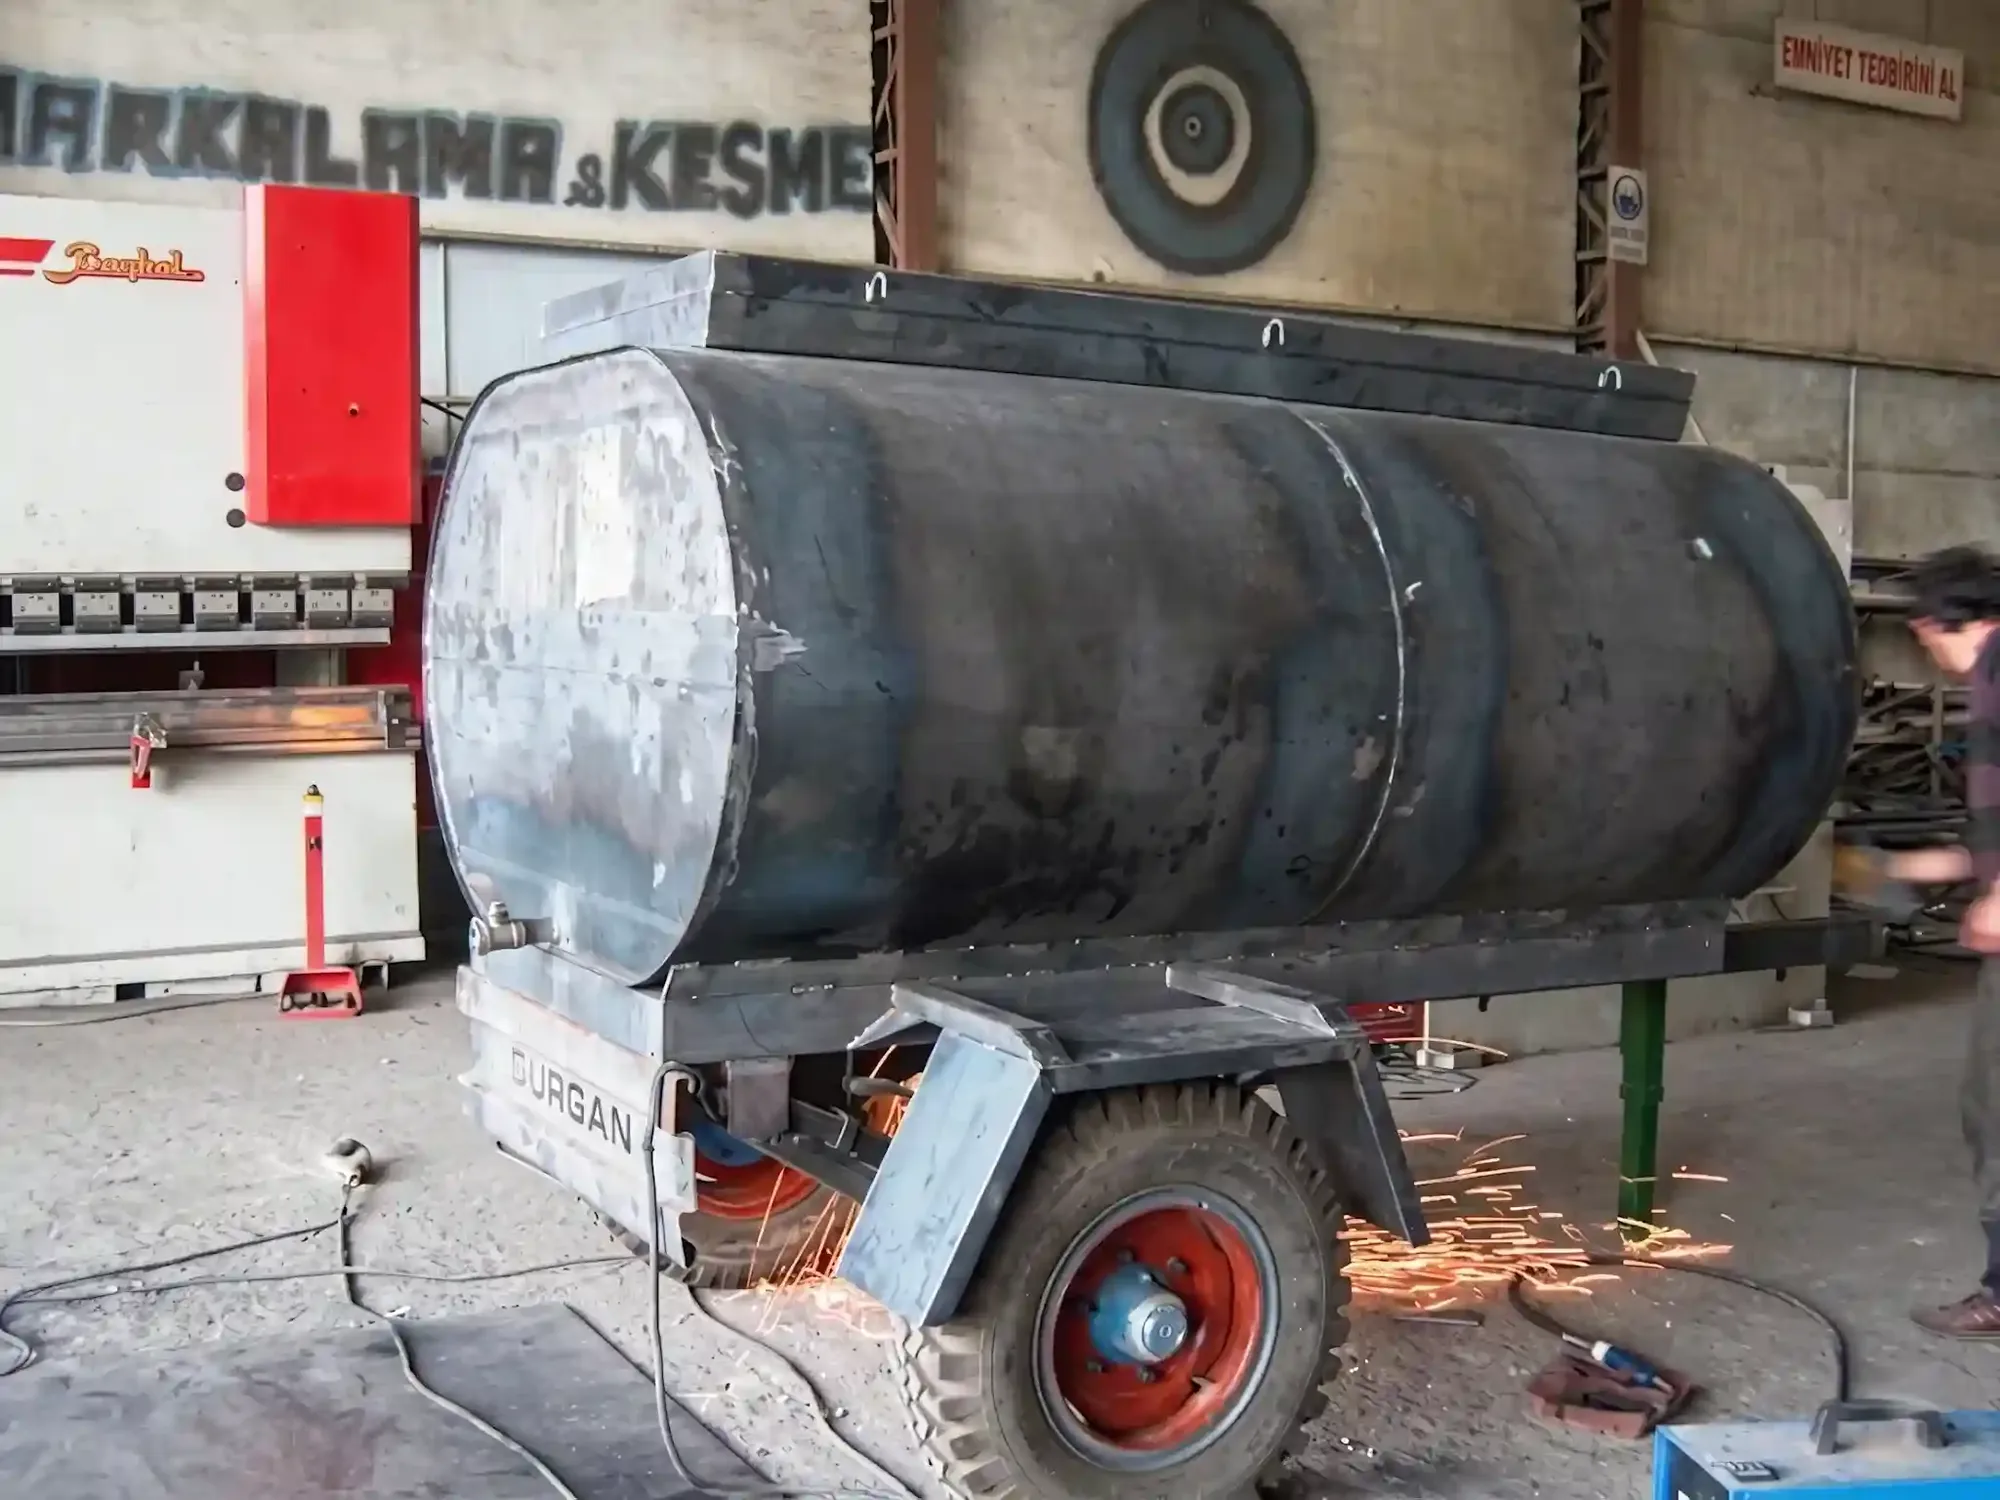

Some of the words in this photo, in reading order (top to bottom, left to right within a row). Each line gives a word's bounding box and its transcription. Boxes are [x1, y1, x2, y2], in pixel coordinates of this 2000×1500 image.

[1939, 67, 1957, 102] AL
[609, 118, 874, 220] KESME
[512, 1046, 631, 1154] DURGAN
